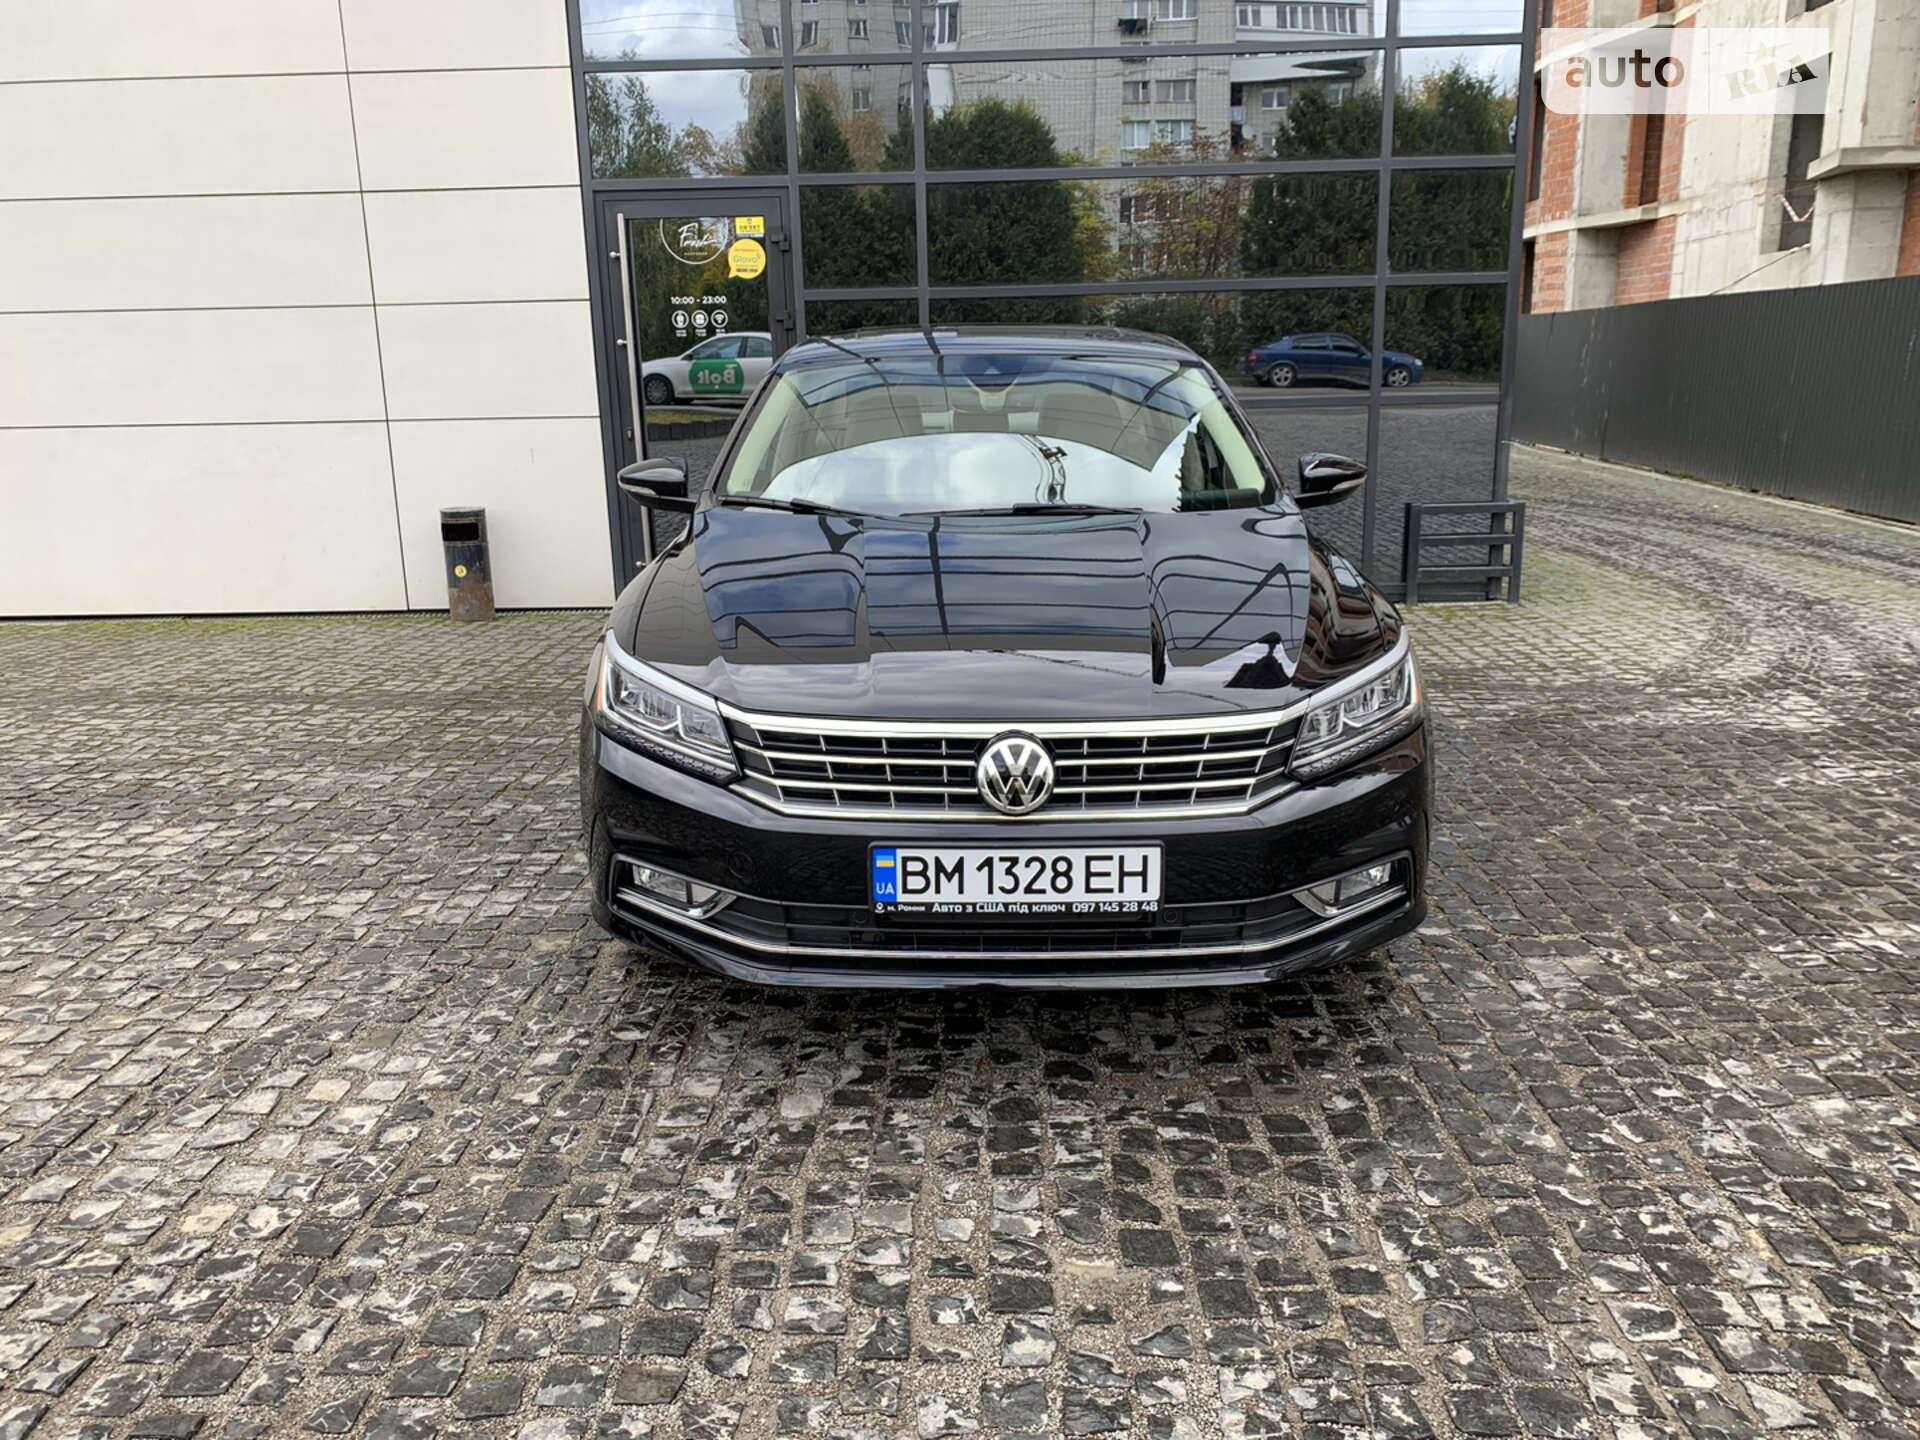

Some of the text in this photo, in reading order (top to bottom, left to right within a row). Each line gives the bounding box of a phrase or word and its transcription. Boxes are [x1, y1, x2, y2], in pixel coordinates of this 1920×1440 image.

[671, 296, 695, 305] 10:00
[702, 295, 727, 304] 23:00
[901, 854, 1149, 895] BM 1328 EH
[876, 882, 895, 895] UA
[932, 902, 963, 913] Авто
[976, 902, 1006, 913] США
[1008, 901, 1030, 914] під
[1032, 903, 1066, 913] ключ
[1072, 902, 1096, 913] 097
[1098, 902, 1120, 912] 145
[1122, 902, 1138, 912] 28
[1141, 901, 1158, 912] 48
